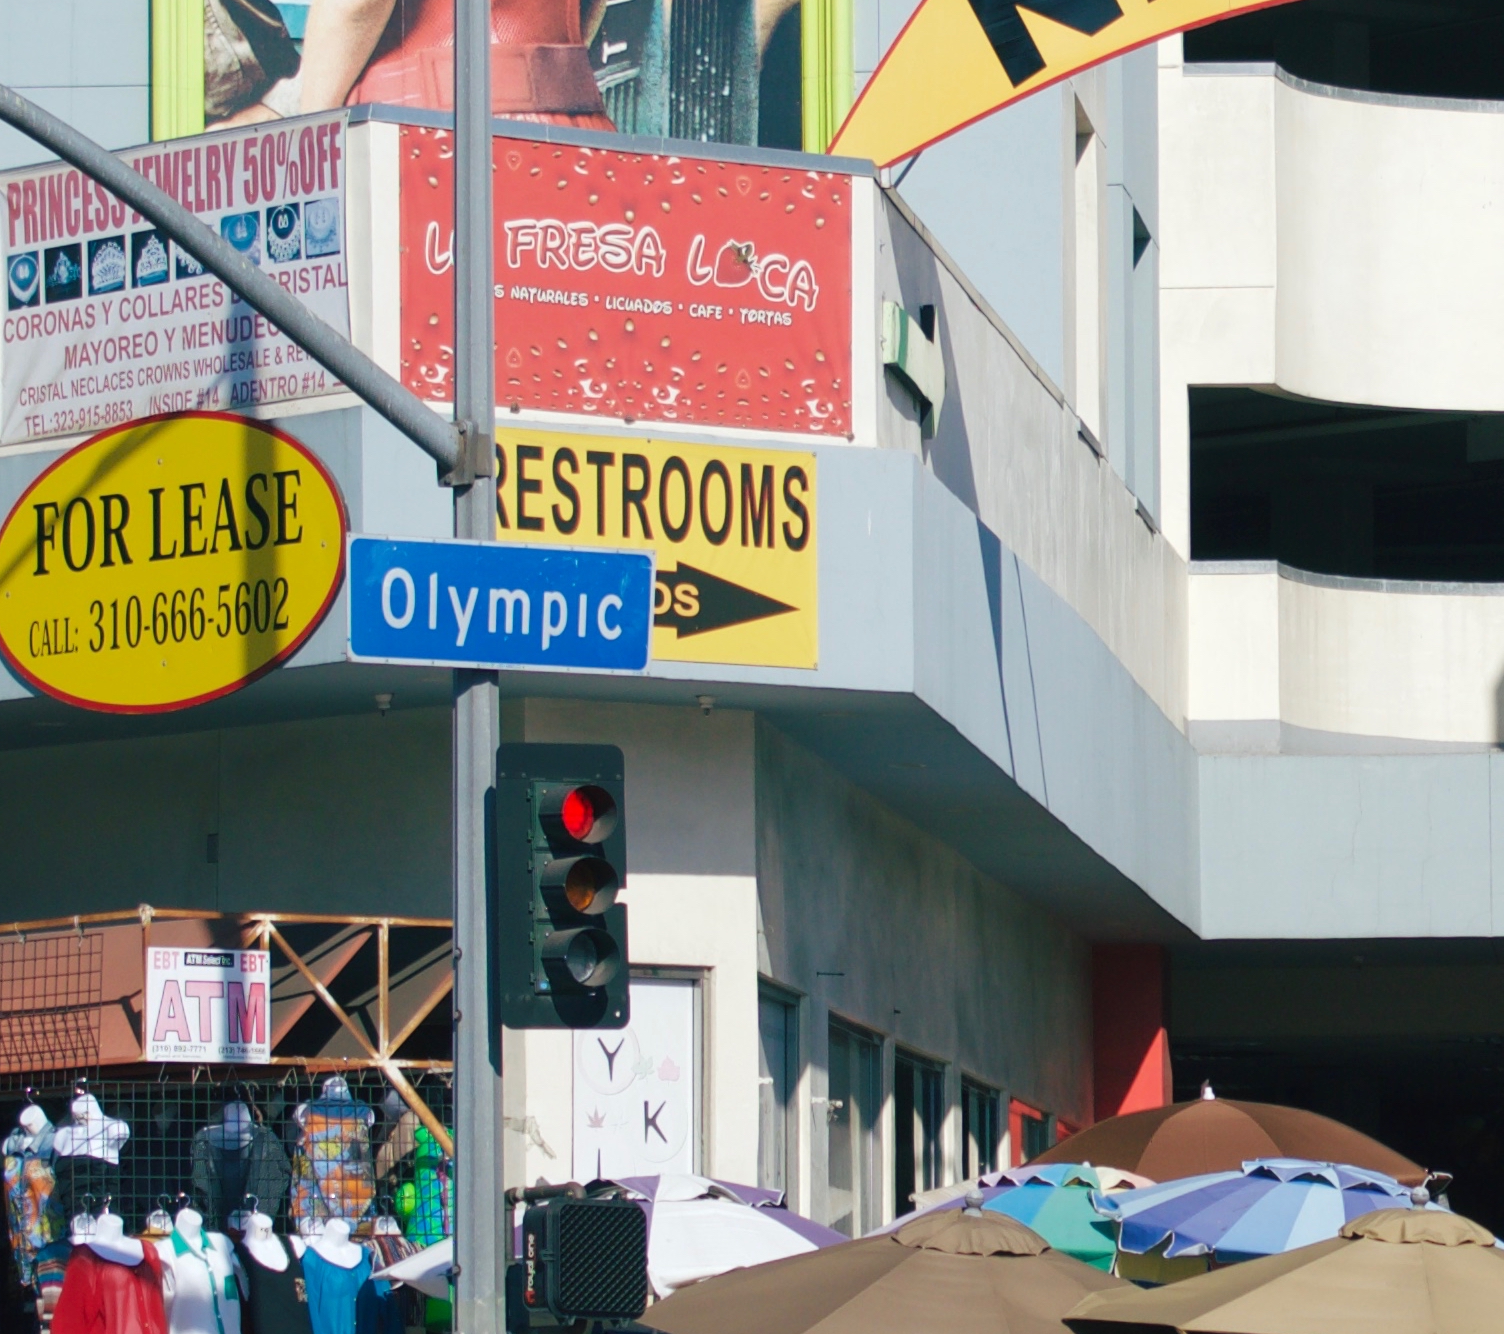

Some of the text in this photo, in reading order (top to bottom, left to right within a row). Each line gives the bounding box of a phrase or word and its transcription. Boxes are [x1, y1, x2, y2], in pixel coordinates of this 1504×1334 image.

[425, 220, 454, 275] L
[504, 220, 667, 278] FRESA
[3, 304, 96, 344] CORONAS
[102, 300, 114, 326] Y
[119, 280, 224, 323] COLLARES
[268, 261, 348, 295] RISTAL
[510, 285, 589, 307] NATURALES
[605, 296, 673, 315] LICUADOS
[689, 303, 723, 320] CAFE
[739, 308, 793, 327] TORTAS
[19, 382, 68, 407] CRISTAL
[71, 369, 134, 399] NECLACES
[138, 362, 191, 388] CROWNS
[194, 348, 271, 378] WHOLESALE
[275, 346, 283, 365] &
[64, 330, 159, 370] MAYOREO
[163, 327, 176, 353] Y
[149, 391, 193, 415] INSIDE
[231, 374, 298, 405] ADENTRO
[301, 370, 326, 395] #14
[34, 469, 304, 577] FOR LEASE
[29, 578, 291, 660] CALL: 310-666-5602
[381, 566, 624, 652] Olympic
[154, 951, 180, 970] EBT
[240, 953, 265, 973] EBT
[153, 979, 266, 1045] ATM
[597, 1036, 625, 1082] Y
[643, 1099, 669, 1145] K
